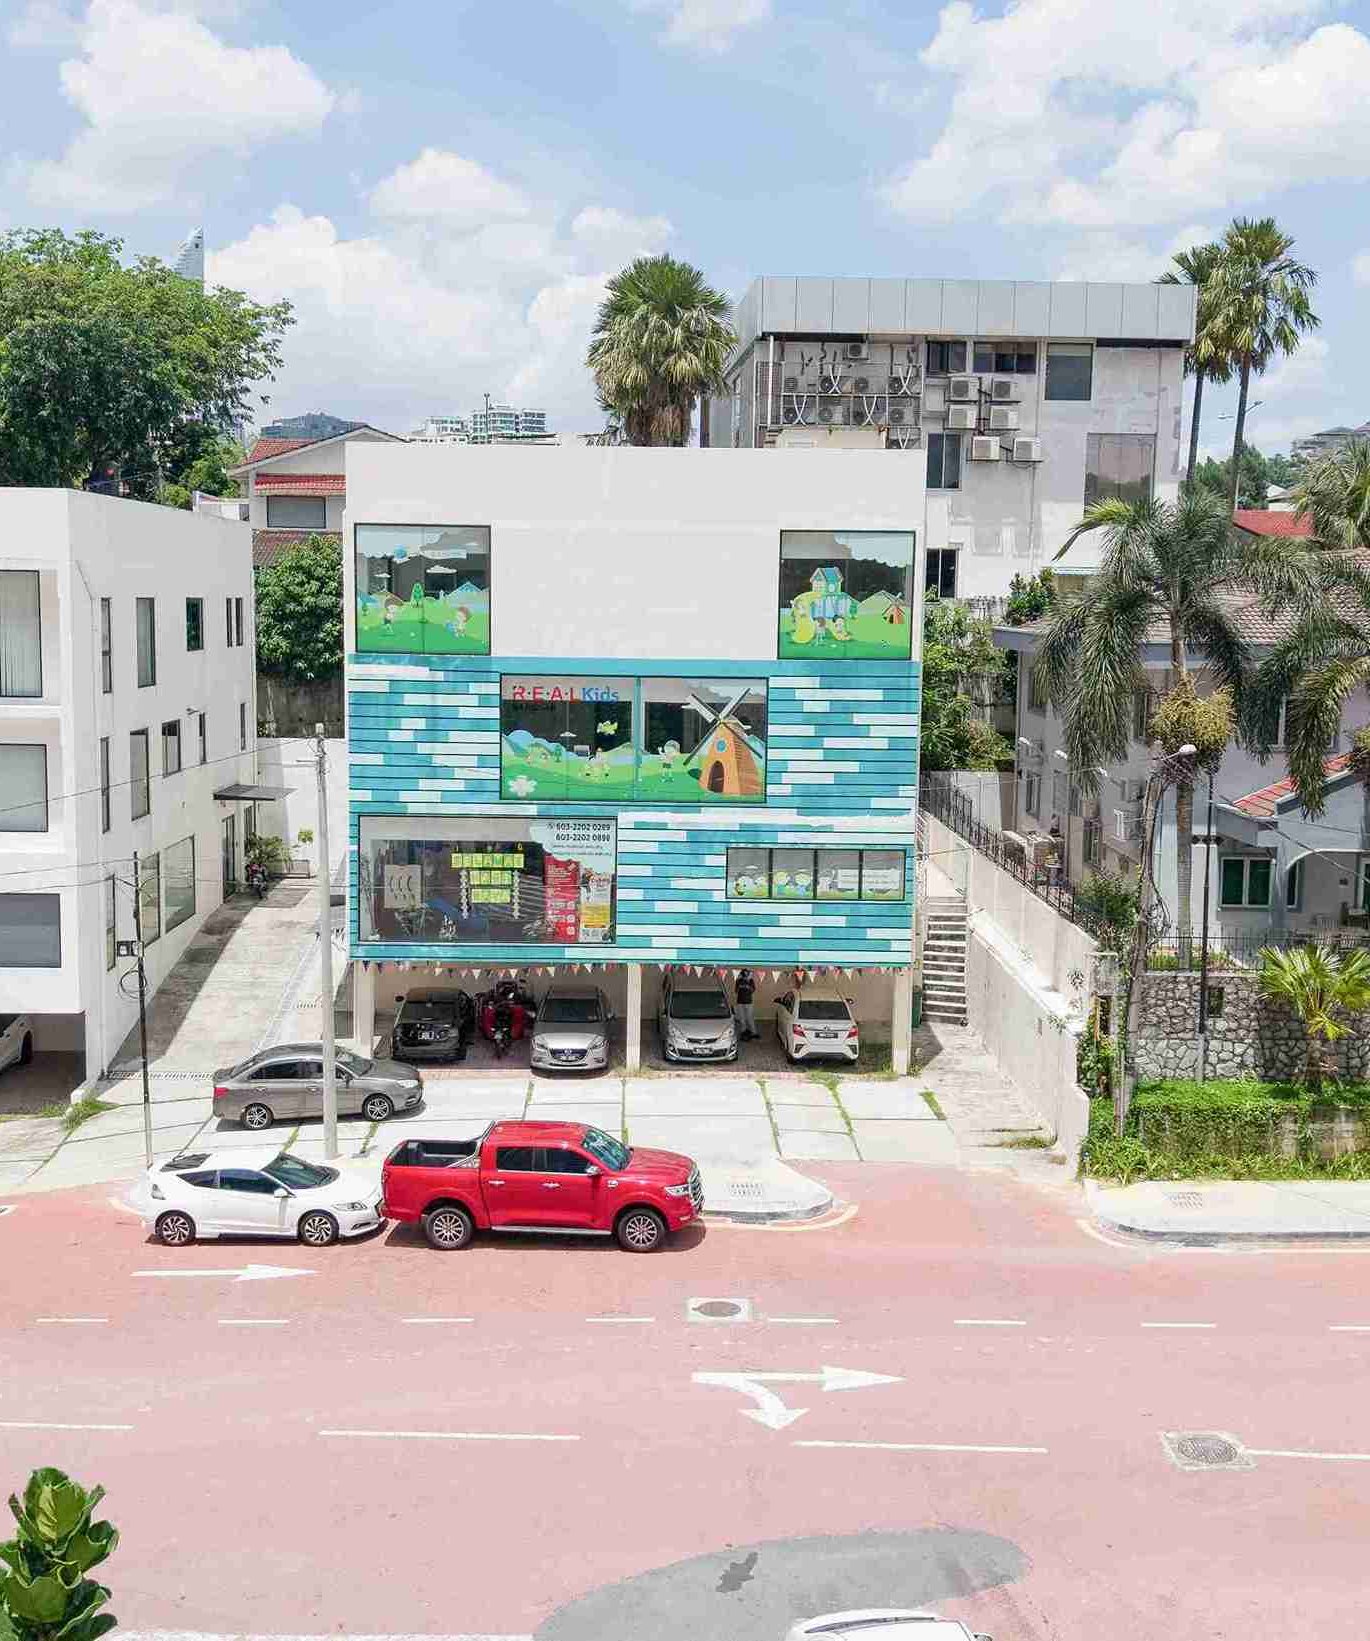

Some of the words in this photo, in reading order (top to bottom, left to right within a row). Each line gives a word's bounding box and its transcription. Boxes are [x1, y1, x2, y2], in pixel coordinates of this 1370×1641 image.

[582, 686, 619, 704] Kids
[556, 823, 591, 831] 603-2202
[556, 833, 591, 841] 603-2202
